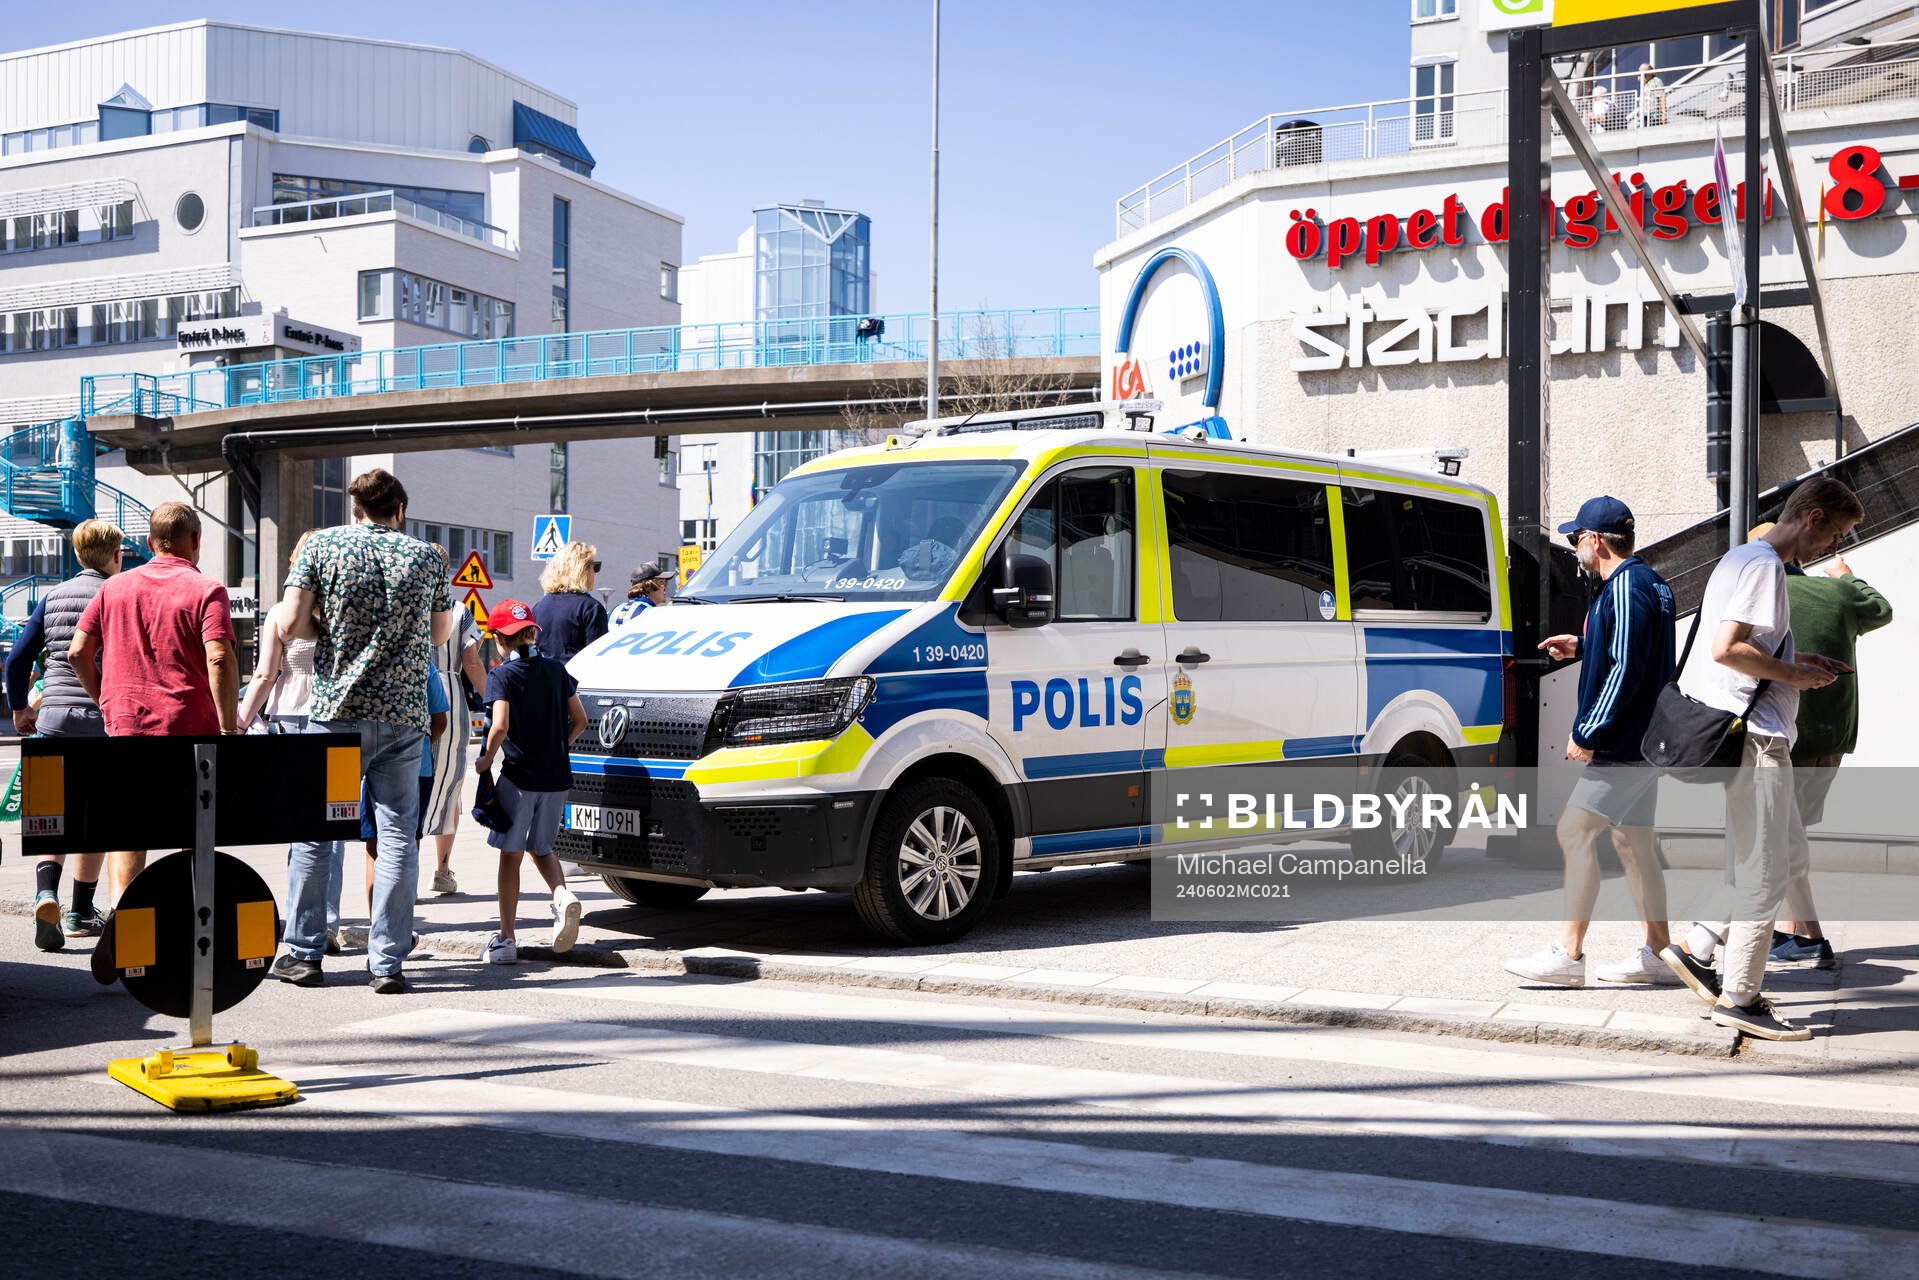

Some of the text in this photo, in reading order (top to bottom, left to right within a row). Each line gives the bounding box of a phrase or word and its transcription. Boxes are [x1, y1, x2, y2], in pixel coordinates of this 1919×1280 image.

[1285, 192, 1465, 269] öppet
[1480, 171, 1773, 249] dgligen
[284, 325, 344, 351] Entré P-hus
[1291, 283, 1681, 370] stadum
[1112, 358, 1146, 401] ICA
[823, 577, 906, 590] 1 39-0420
[595, 631, 754, 658] POLIS
[913, 643, 985, 662] 1 39-0420
[1011, 675, 1143, 732] POLIS
[575, 807, 634, 832] KMH 09H
